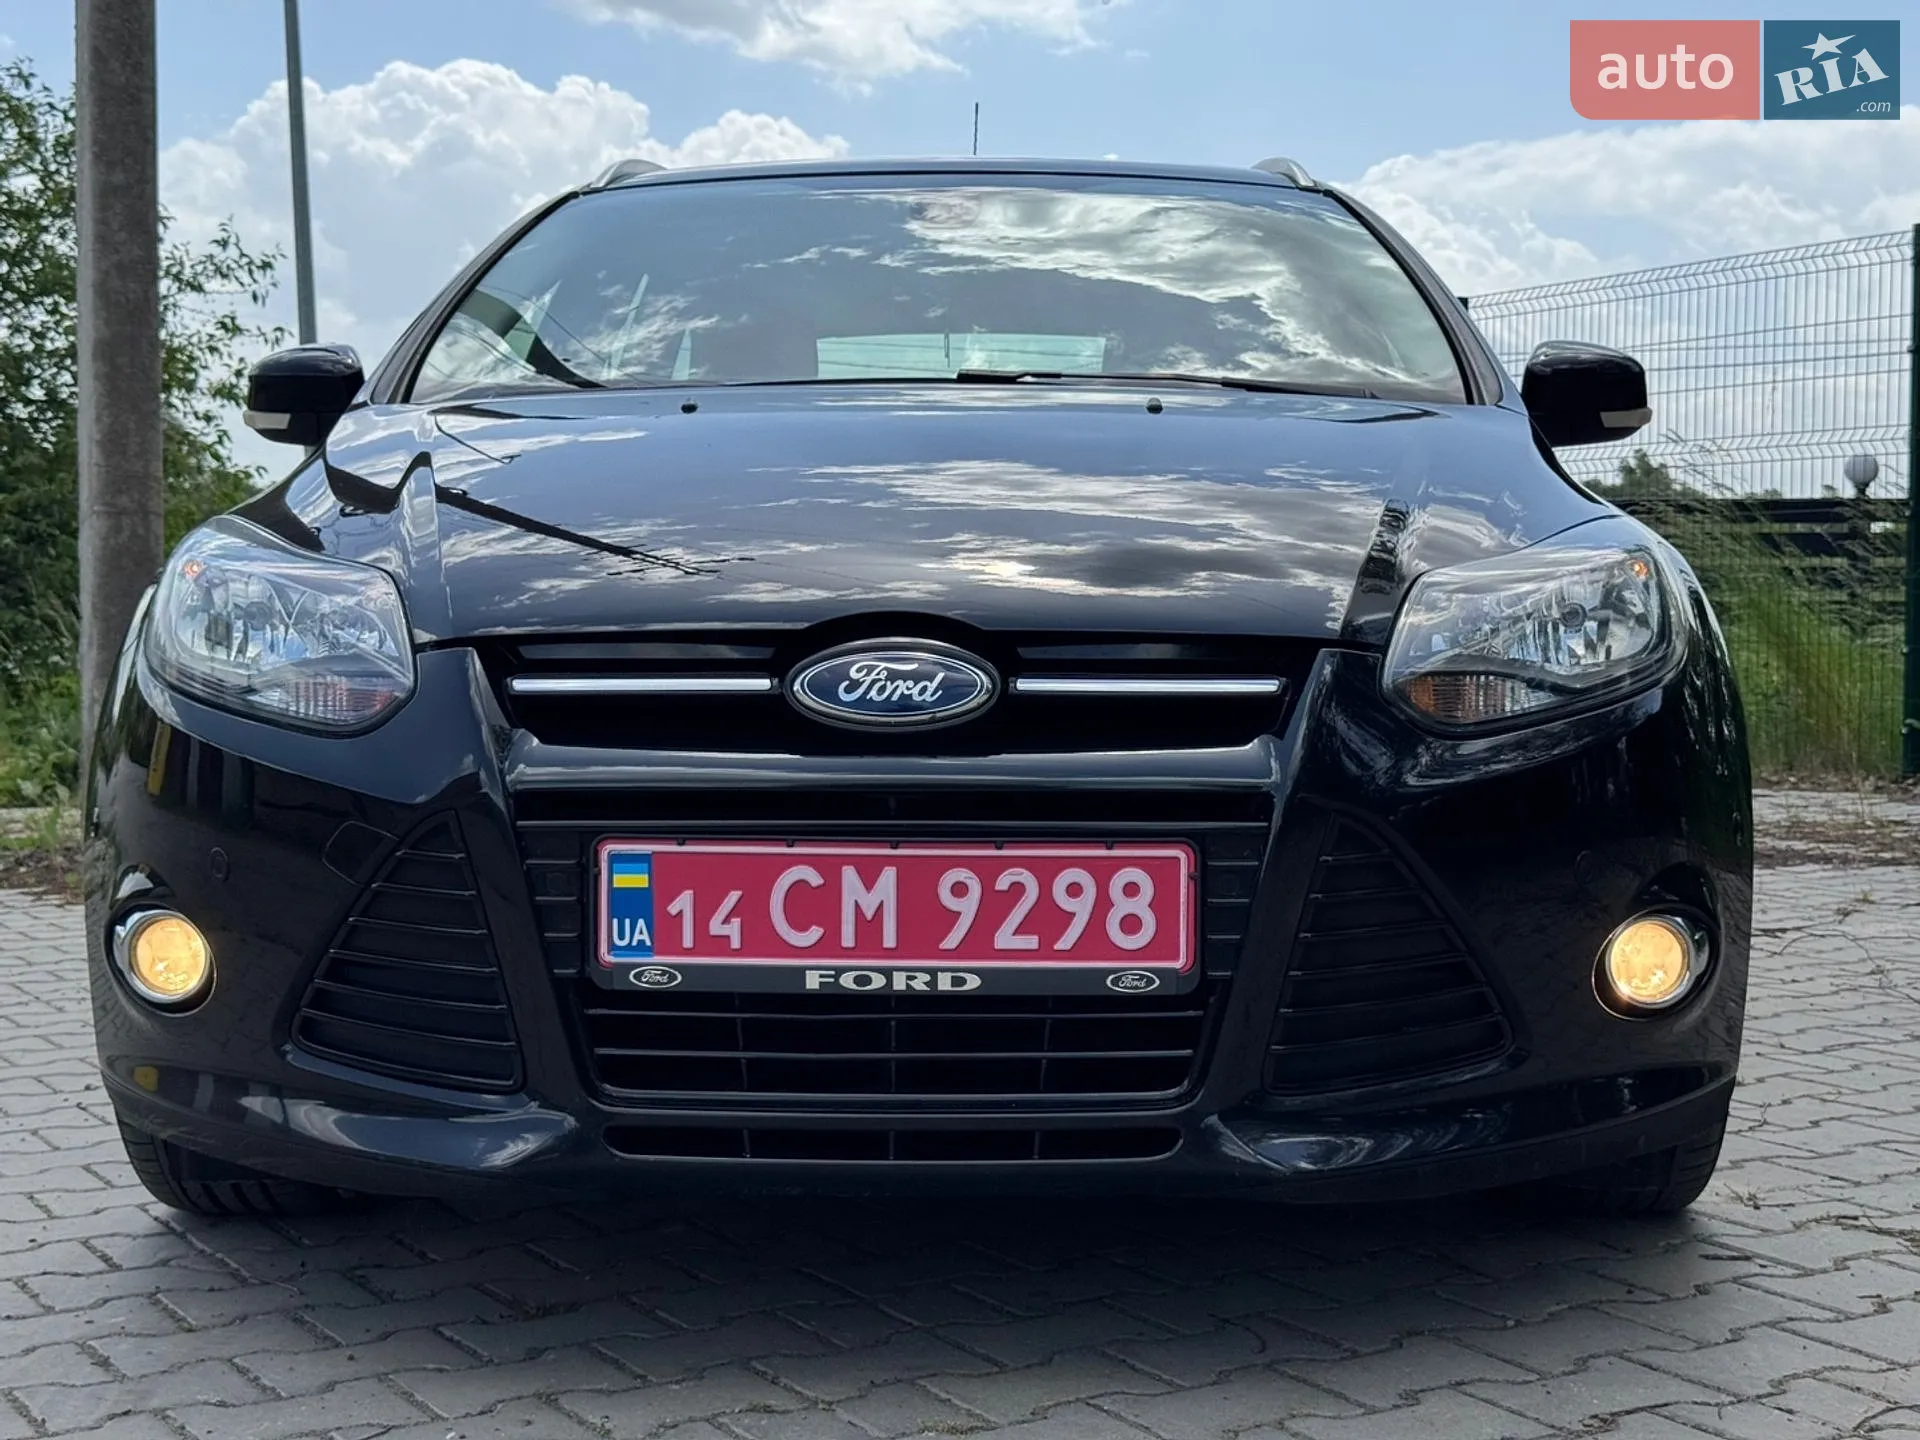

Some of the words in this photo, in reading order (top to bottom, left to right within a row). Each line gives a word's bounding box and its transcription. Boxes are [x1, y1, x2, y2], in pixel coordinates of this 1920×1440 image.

[837, 661, 945, 702] Ford
[667, 890, 743, 950] 14
[769, 865, 898, 949] CM
[937, 867, 1157, 951] 9298
[612, 918, 651, 946] UA
[641, 969, 670, 983] Ford
[805, 970, 982, 992] FORD
[1118, 974, 1147, 988] Ford
